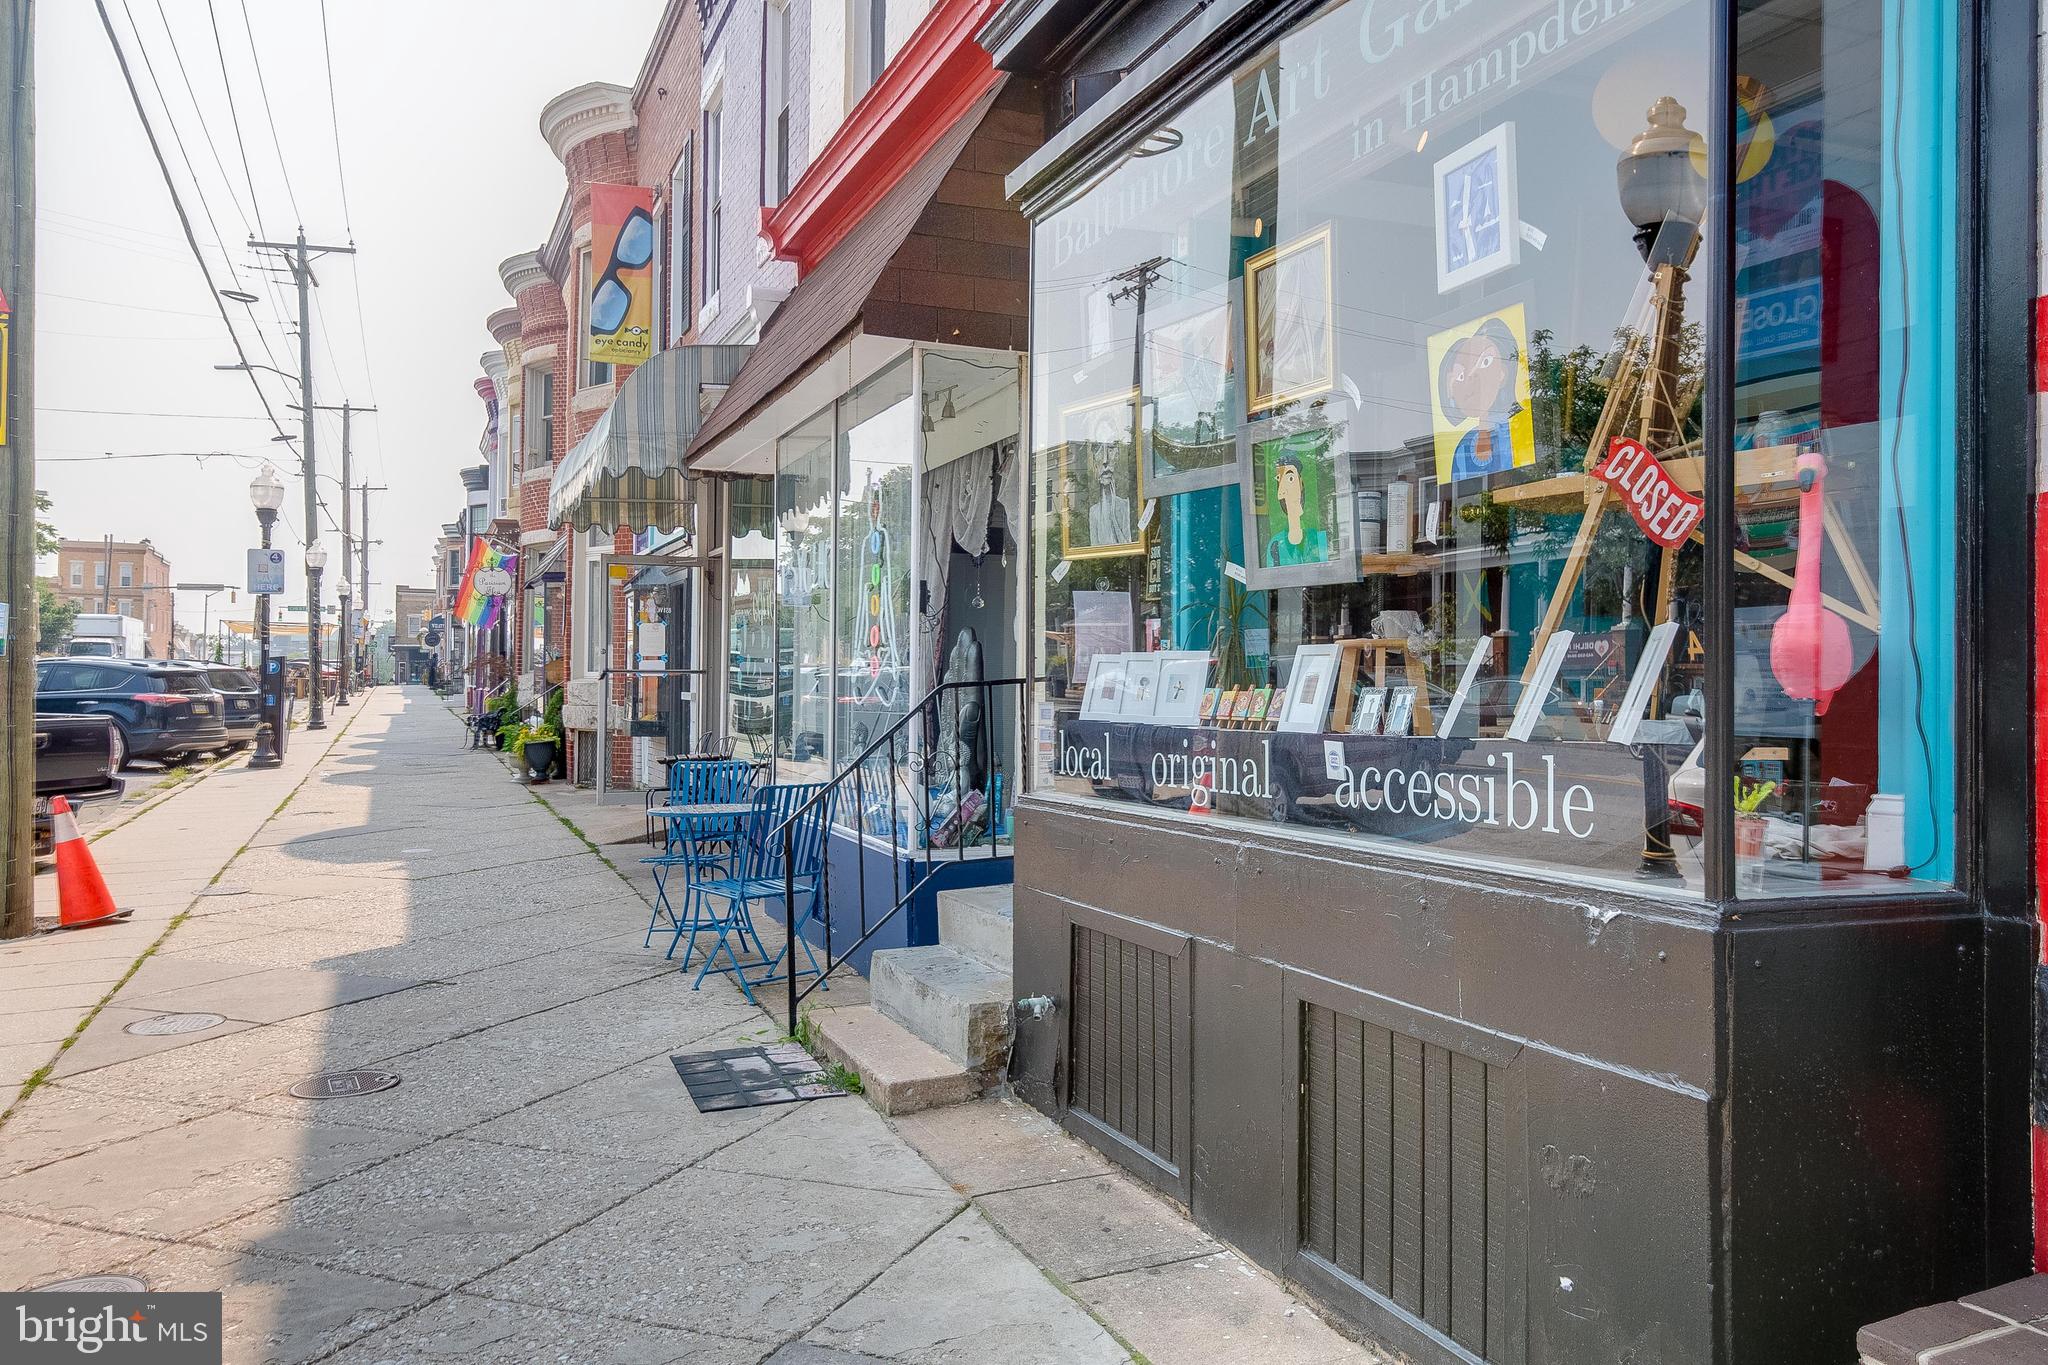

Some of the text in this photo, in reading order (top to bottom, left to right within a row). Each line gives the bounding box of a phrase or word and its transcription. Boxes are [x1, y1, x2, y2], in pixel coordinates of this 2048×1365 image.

[1054, 122, 1225, 267] Baltimore
[1243, 42, 1331, 147] Art
[1351, 113, 1386, 162] in
[595, 336, 648, 351] eye candy
[1604, 445, 1699, 541] CLOSED
[1058, 729, 1594, 839] local original accessible
